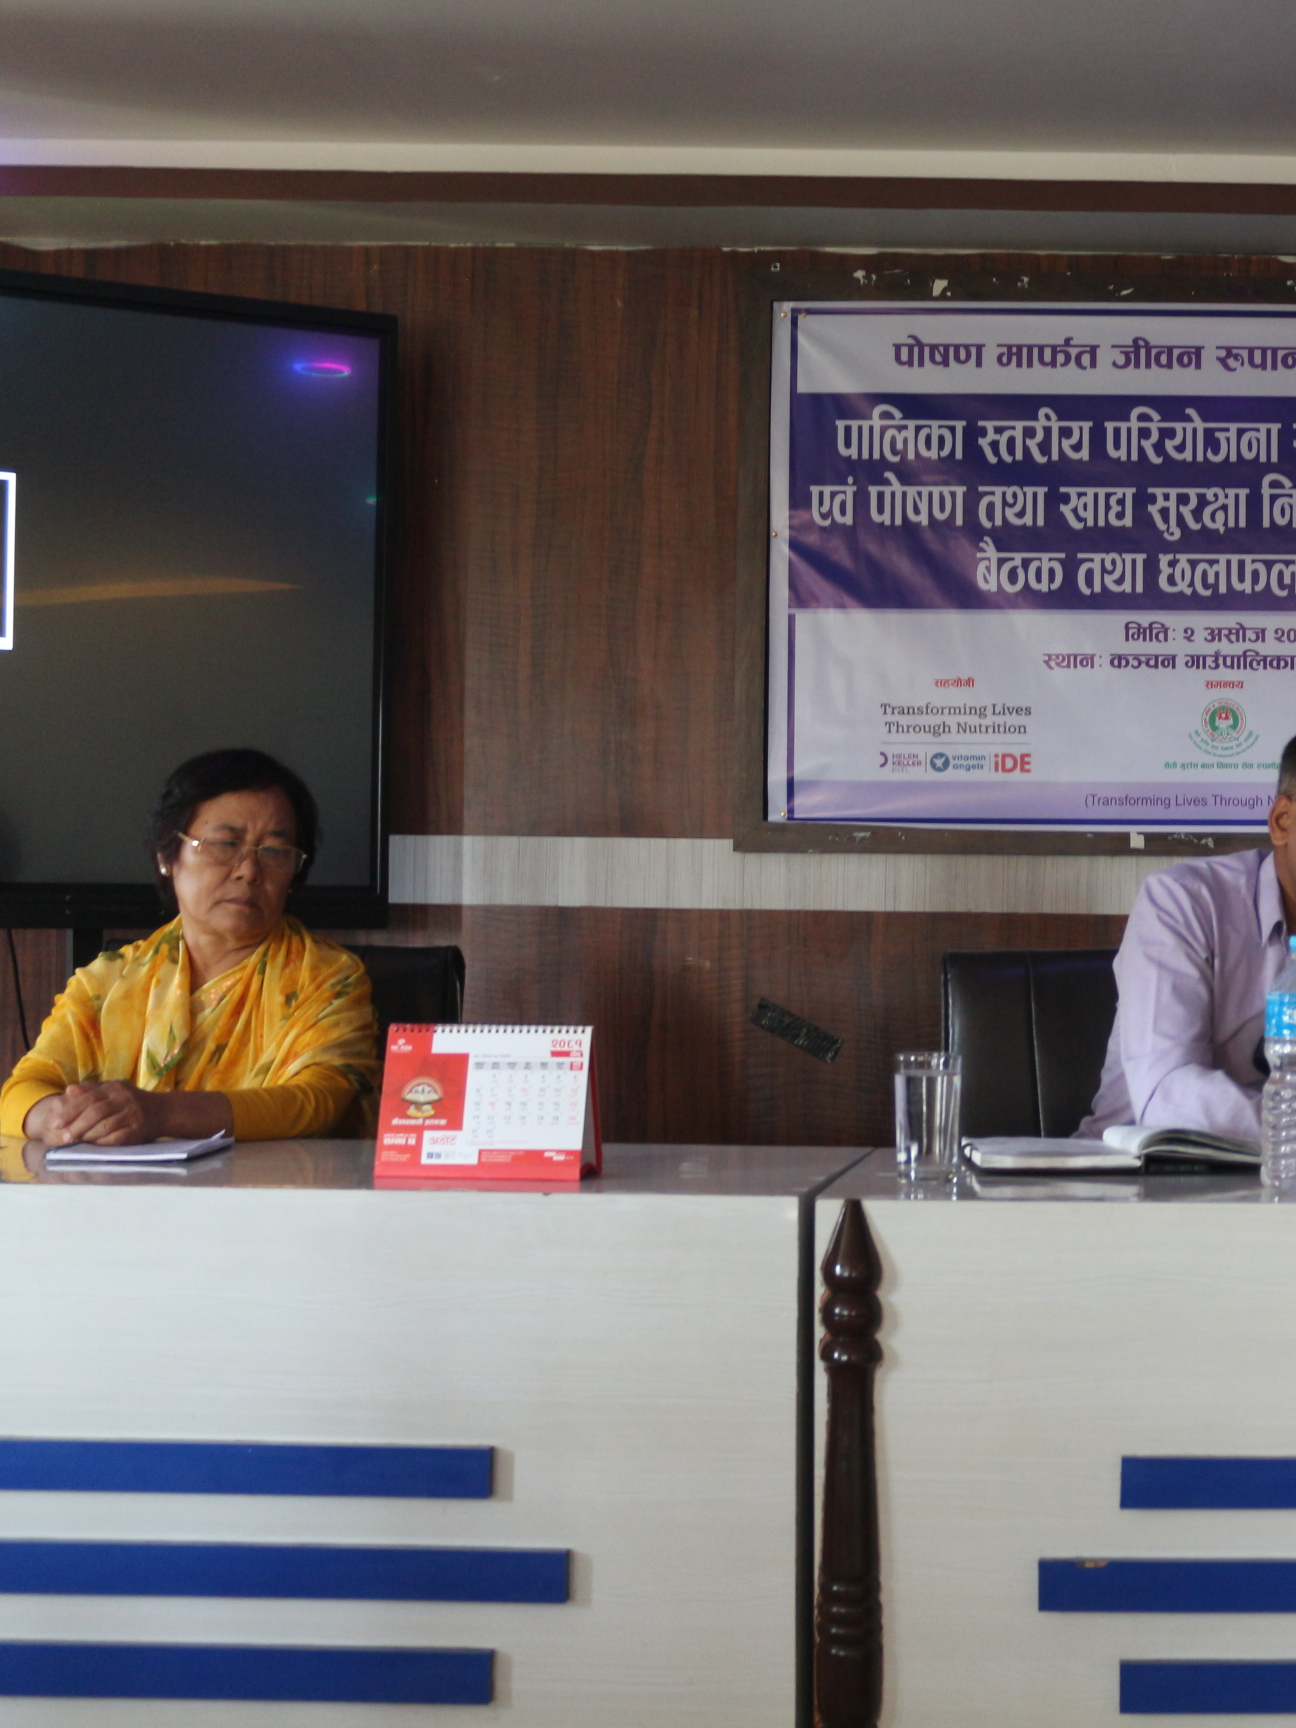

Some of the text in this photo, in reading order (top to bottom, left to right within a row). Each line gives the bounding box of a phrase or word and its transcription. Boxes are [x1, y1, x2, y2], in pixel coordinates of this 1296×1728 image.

[893, 335, 985, 368] पोषण
[996, 337, 1100, 370] मार्फत
[1111, 337, 1204, 370] जीवन
[836, 404, 966, 463] पालिका
[977, 407, 1094, 464] स्तरीय
[1105, 406, 1281, 464] परियोजना
[810, 477, 857, 527] एवं
[869, 471, 967, 527] पोषण
[978, 485, 1047, 528] तथा
[1060, 486, 1136, 530] खाद्य
[1148, 487, 1249, 541] सुरक्षा
[976, 536, 1065, 594] बैठक
[1077, 552, 1147, 594] तथा
[1183, 627, 1196, 643] २
[1203, 623, 1266, 644] असोज
[1109, 653, 1176, 671] कञ्चन
[934, 676, 975, 688] सहयोगी
[1204, 680, 1245, 690] समन्वय
[880, 702, 1032, 719] Transforming Lives
[884, 721, 1027, 737] Through Nutrition
[994, 753, 1032, 773] iDE
[1085, 794, 1171, 810] (Transforming
[1175, 795, 1208, 807] Lives
[1211, 794, 1264, 810] Through
